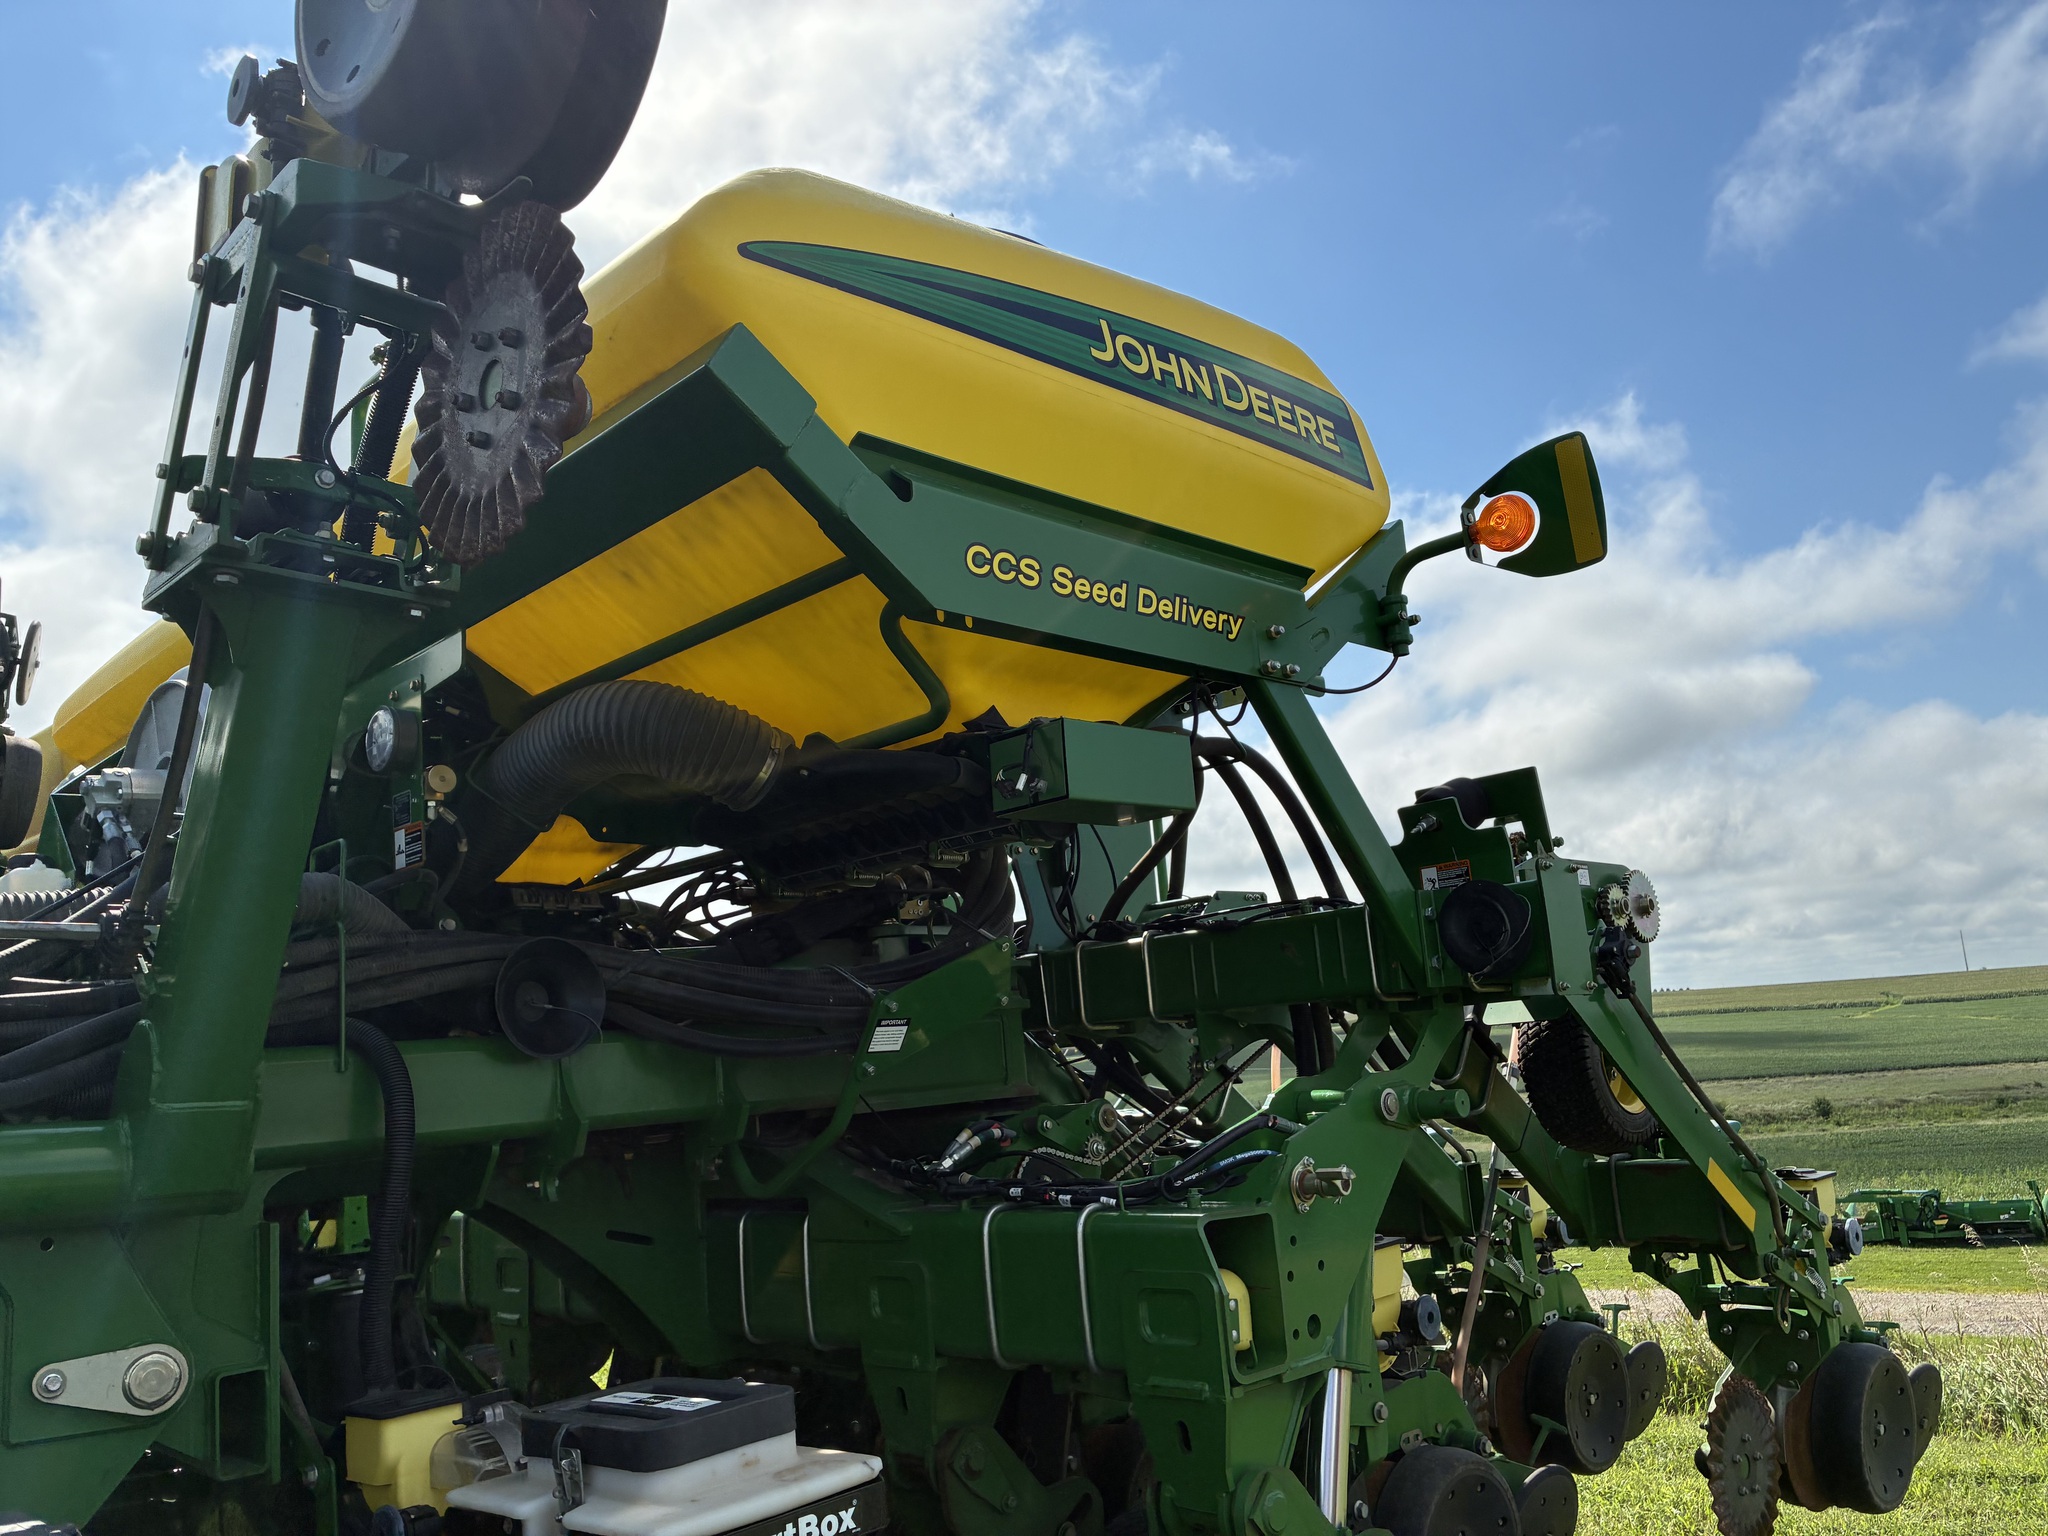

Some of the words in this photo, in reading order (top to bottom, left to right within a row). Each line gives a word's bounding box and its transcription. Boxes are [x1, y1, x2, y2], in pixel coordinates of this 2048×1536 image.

[1090, 319, 1213, 400] JOHN
[1213, 364, 1340, 453] DEERE
[965, 545, 1041, 588] CCS
[1051, 567, 1128, 609] Seed
[1137, 587, 1243, 640] Delivery
